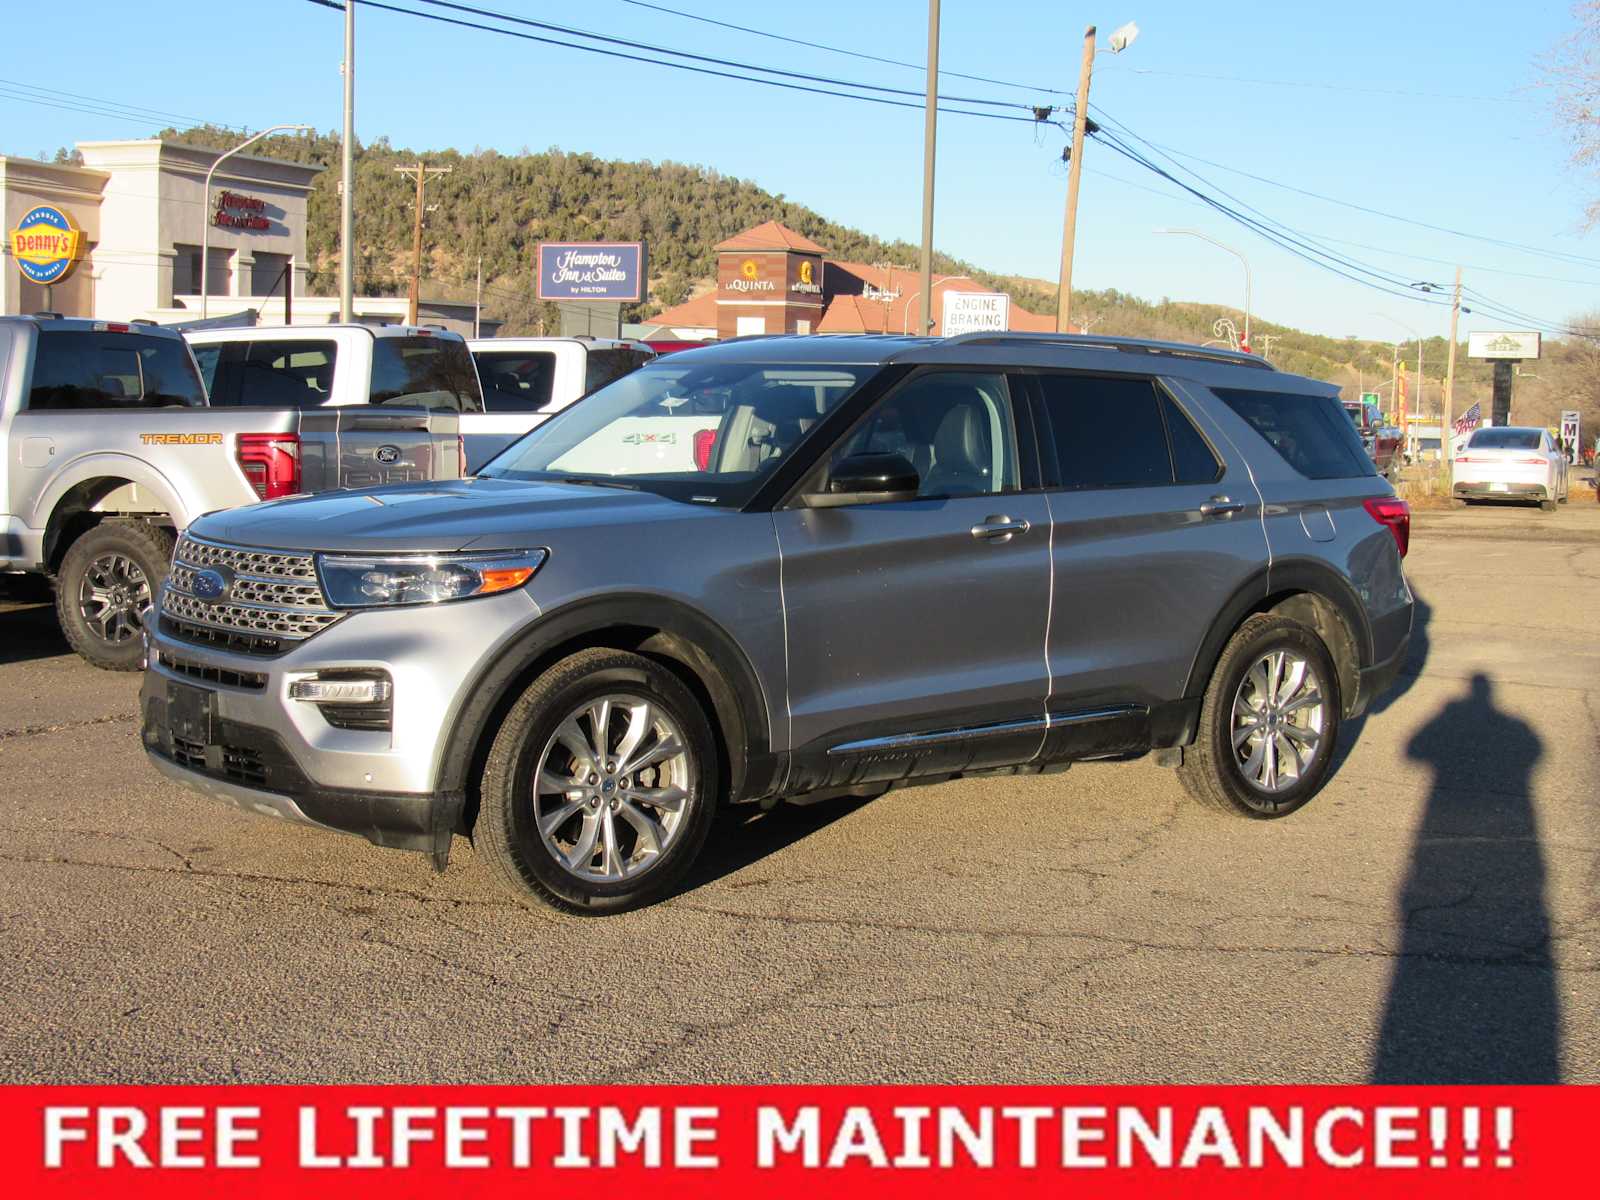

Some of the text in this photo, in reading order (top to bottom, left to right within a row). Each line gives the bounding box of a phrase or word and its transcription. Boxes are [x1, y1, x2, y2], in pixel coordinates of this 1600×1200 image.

[15, 233, 69, 254] Denny's
[556, 249, 621, 269] Hampton
[552, 267, 627, 284] Inn & Suites
[954, 298, 997, 311] ENGINE
[950, 313, 1001, 327] BRAKING
[139, 433, 223, 445] TREMOR
